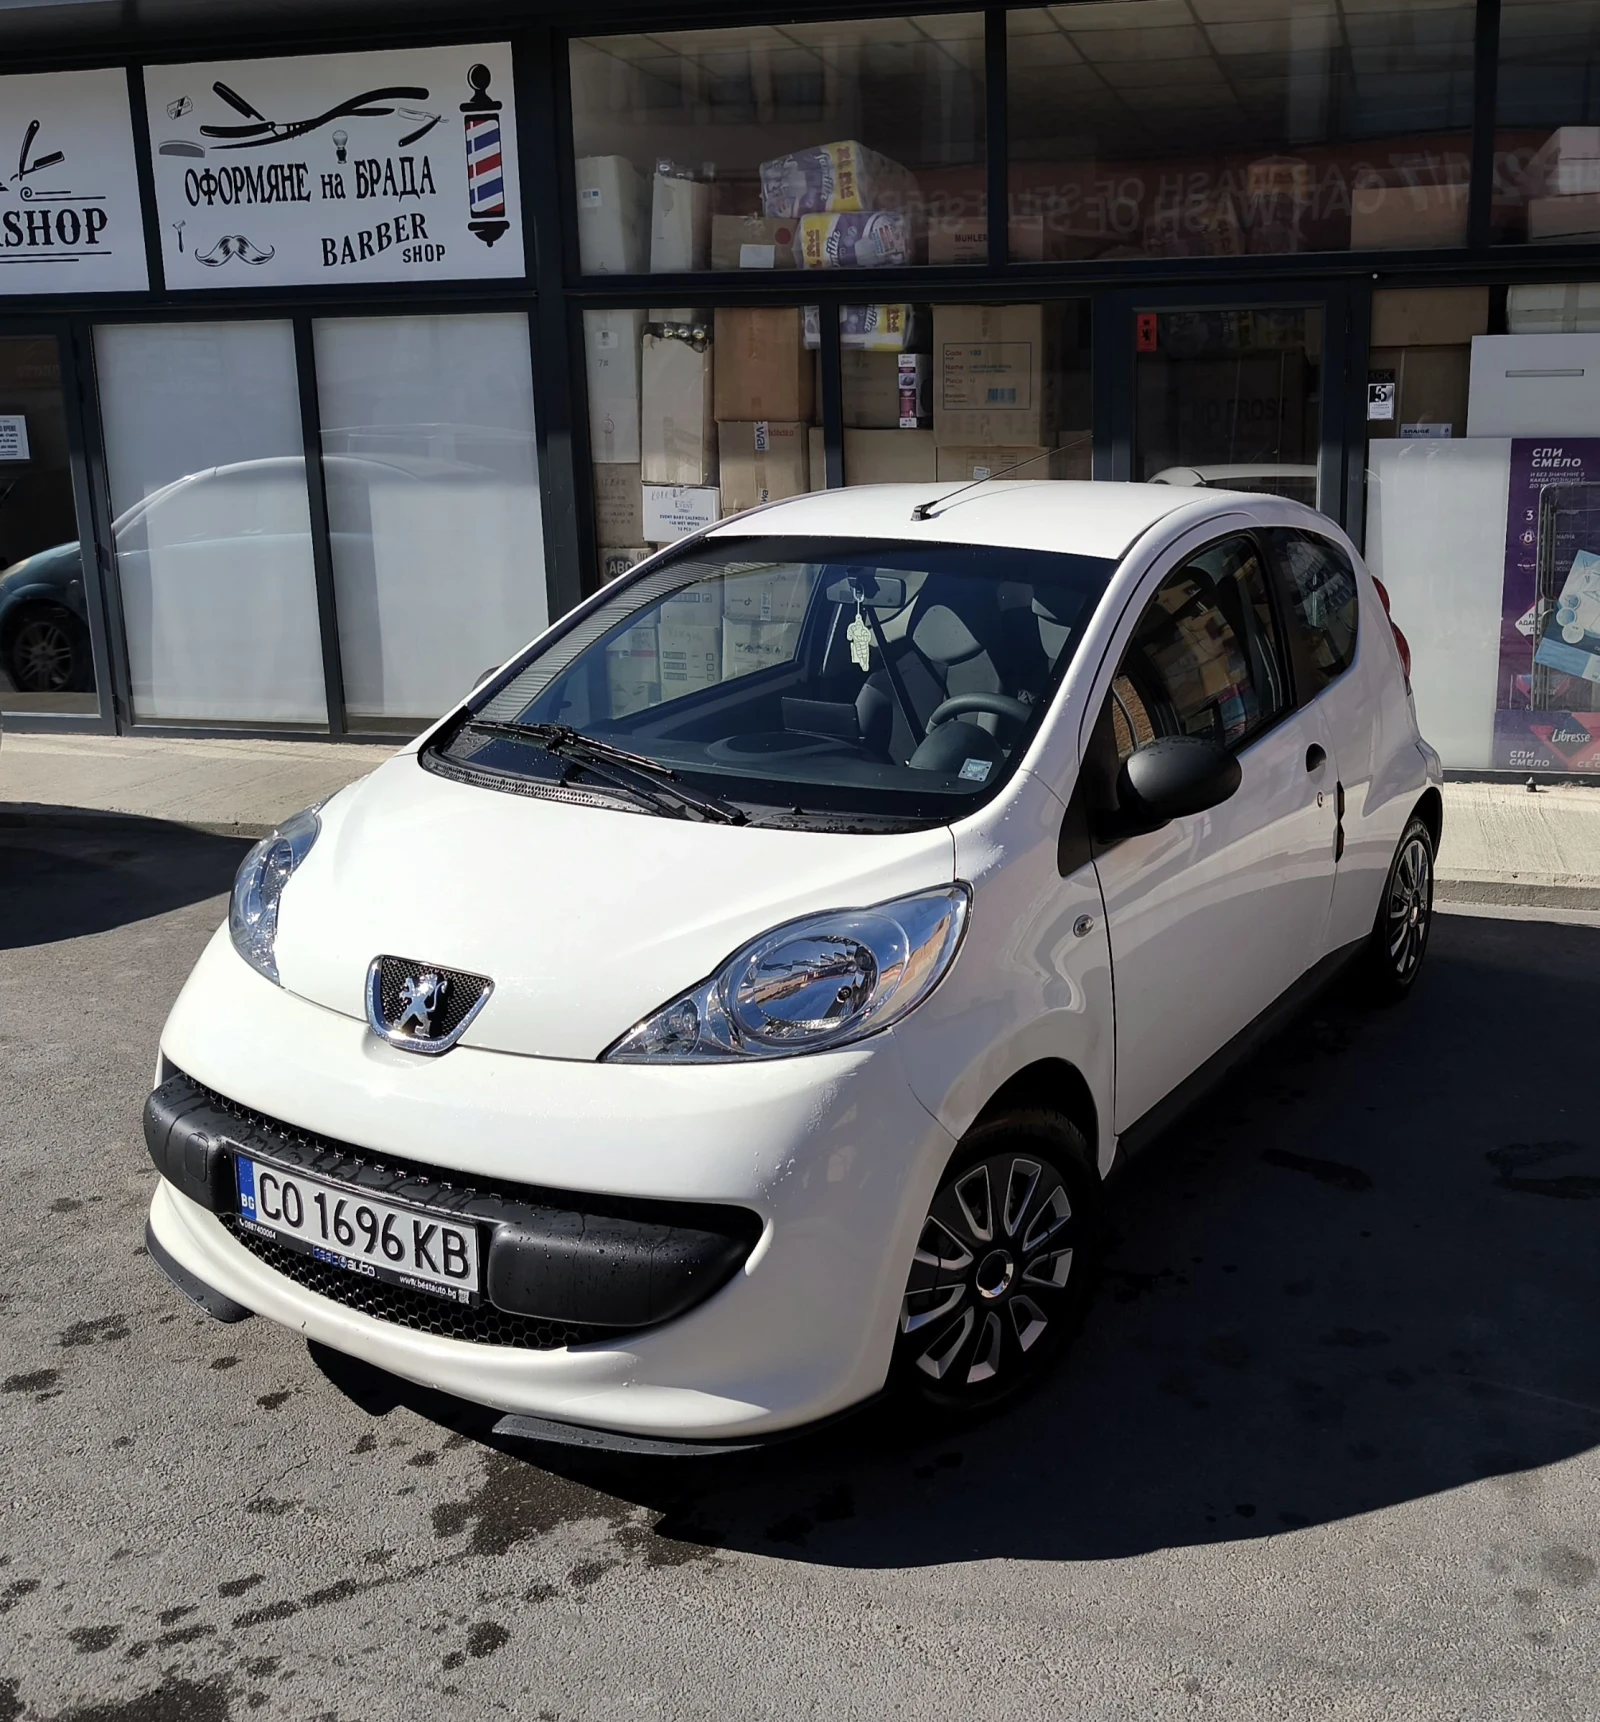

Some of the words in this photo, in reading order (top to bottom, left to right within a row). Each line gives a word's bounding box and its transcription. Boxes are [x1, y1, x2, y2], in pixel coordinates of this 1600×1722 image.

[184, 162, 311, 207] ОФОРМЯНЕ
[321, 173, 346, 200] на
[355, 155, 437, 200] БРАДА
[0, 207, 108, 247] SHOP
[321, 212, 429, 268] BARBER
[402, 243, 446, 264] SHOP
[1532, 448, 1563, 458] СПИ
[1531, 458, 1582, 467] СМЕЛО
[1526, 510, 1534, 520] 3
[1552, 729, 1591, 742] Libresse
[1509, 758, 1550, 767] СМЕЛО
[1510, 750, 1535, 759] СПИ
[241, 1193, 255, 1211] BG
[259, 1171, 304, 1228] CO
[314, 1191, 405, 1262] 1696
[412, 1219, 471, 1279] KB
[399, 1275, 457, 1300] www.bestauto.bg
